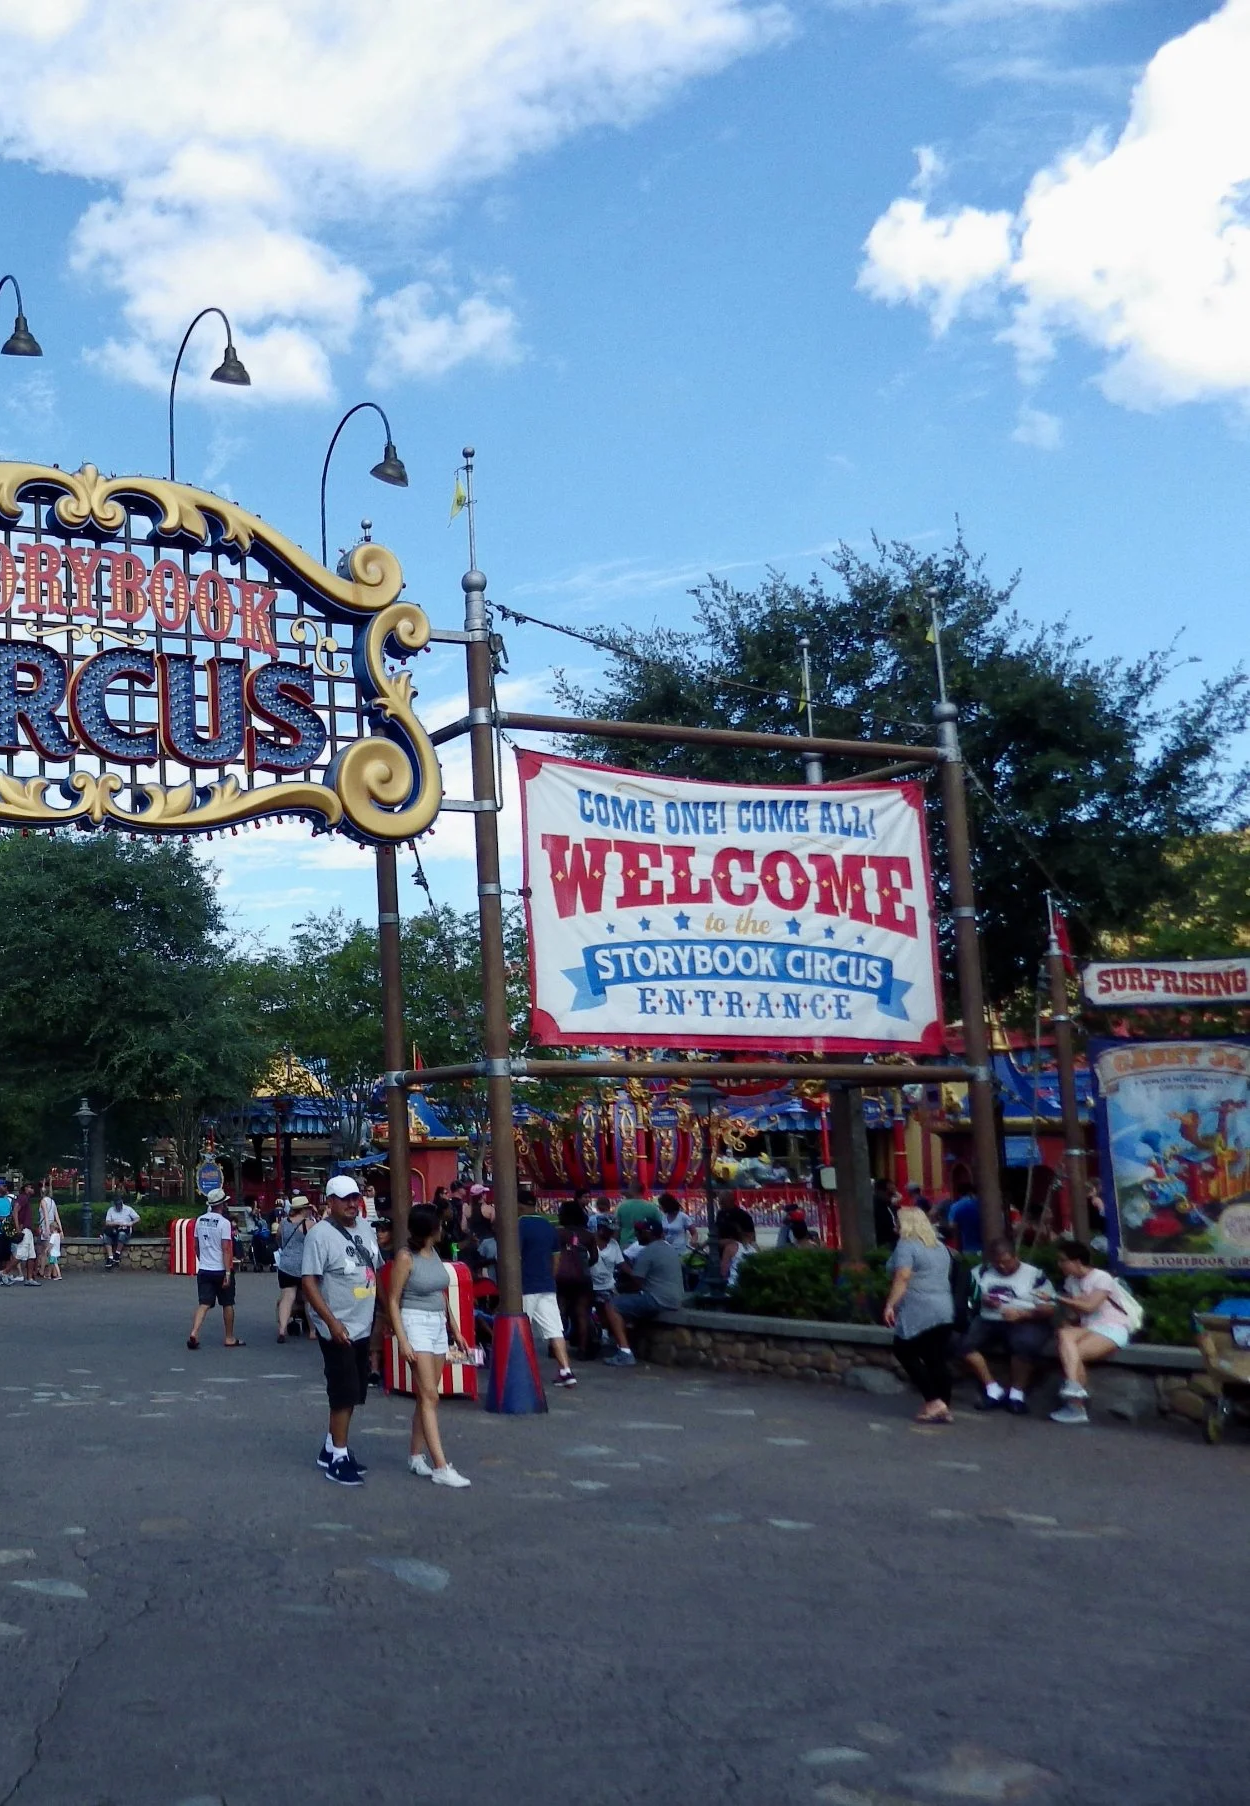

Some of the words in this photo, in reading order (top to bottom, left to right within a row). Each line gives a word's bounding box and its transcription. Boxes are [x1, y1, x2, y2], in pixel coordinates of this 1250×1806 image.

[577, 788, 656, 834] COME
[665, 801, 727, 835] ONE!
[736, 800, 809, 834] COME
[819, 802, 877, 840] ALL!
[541, 833, 918, 939] WELCOME
[704, 913, 727, 935] to
[735, 908, 771, 936] the
[594, 945, 779, 981] STORYBOOK
[785, 950, 883, 990] CIRCUS
[1096, 967, 1248, 997] SURPRISING
[637, 986, 852, 1021] ENTRANCE
[1113, 1046, 1203, 1073] CASEY
[1151, 1256, 1226, 1266] STORYBOOK
